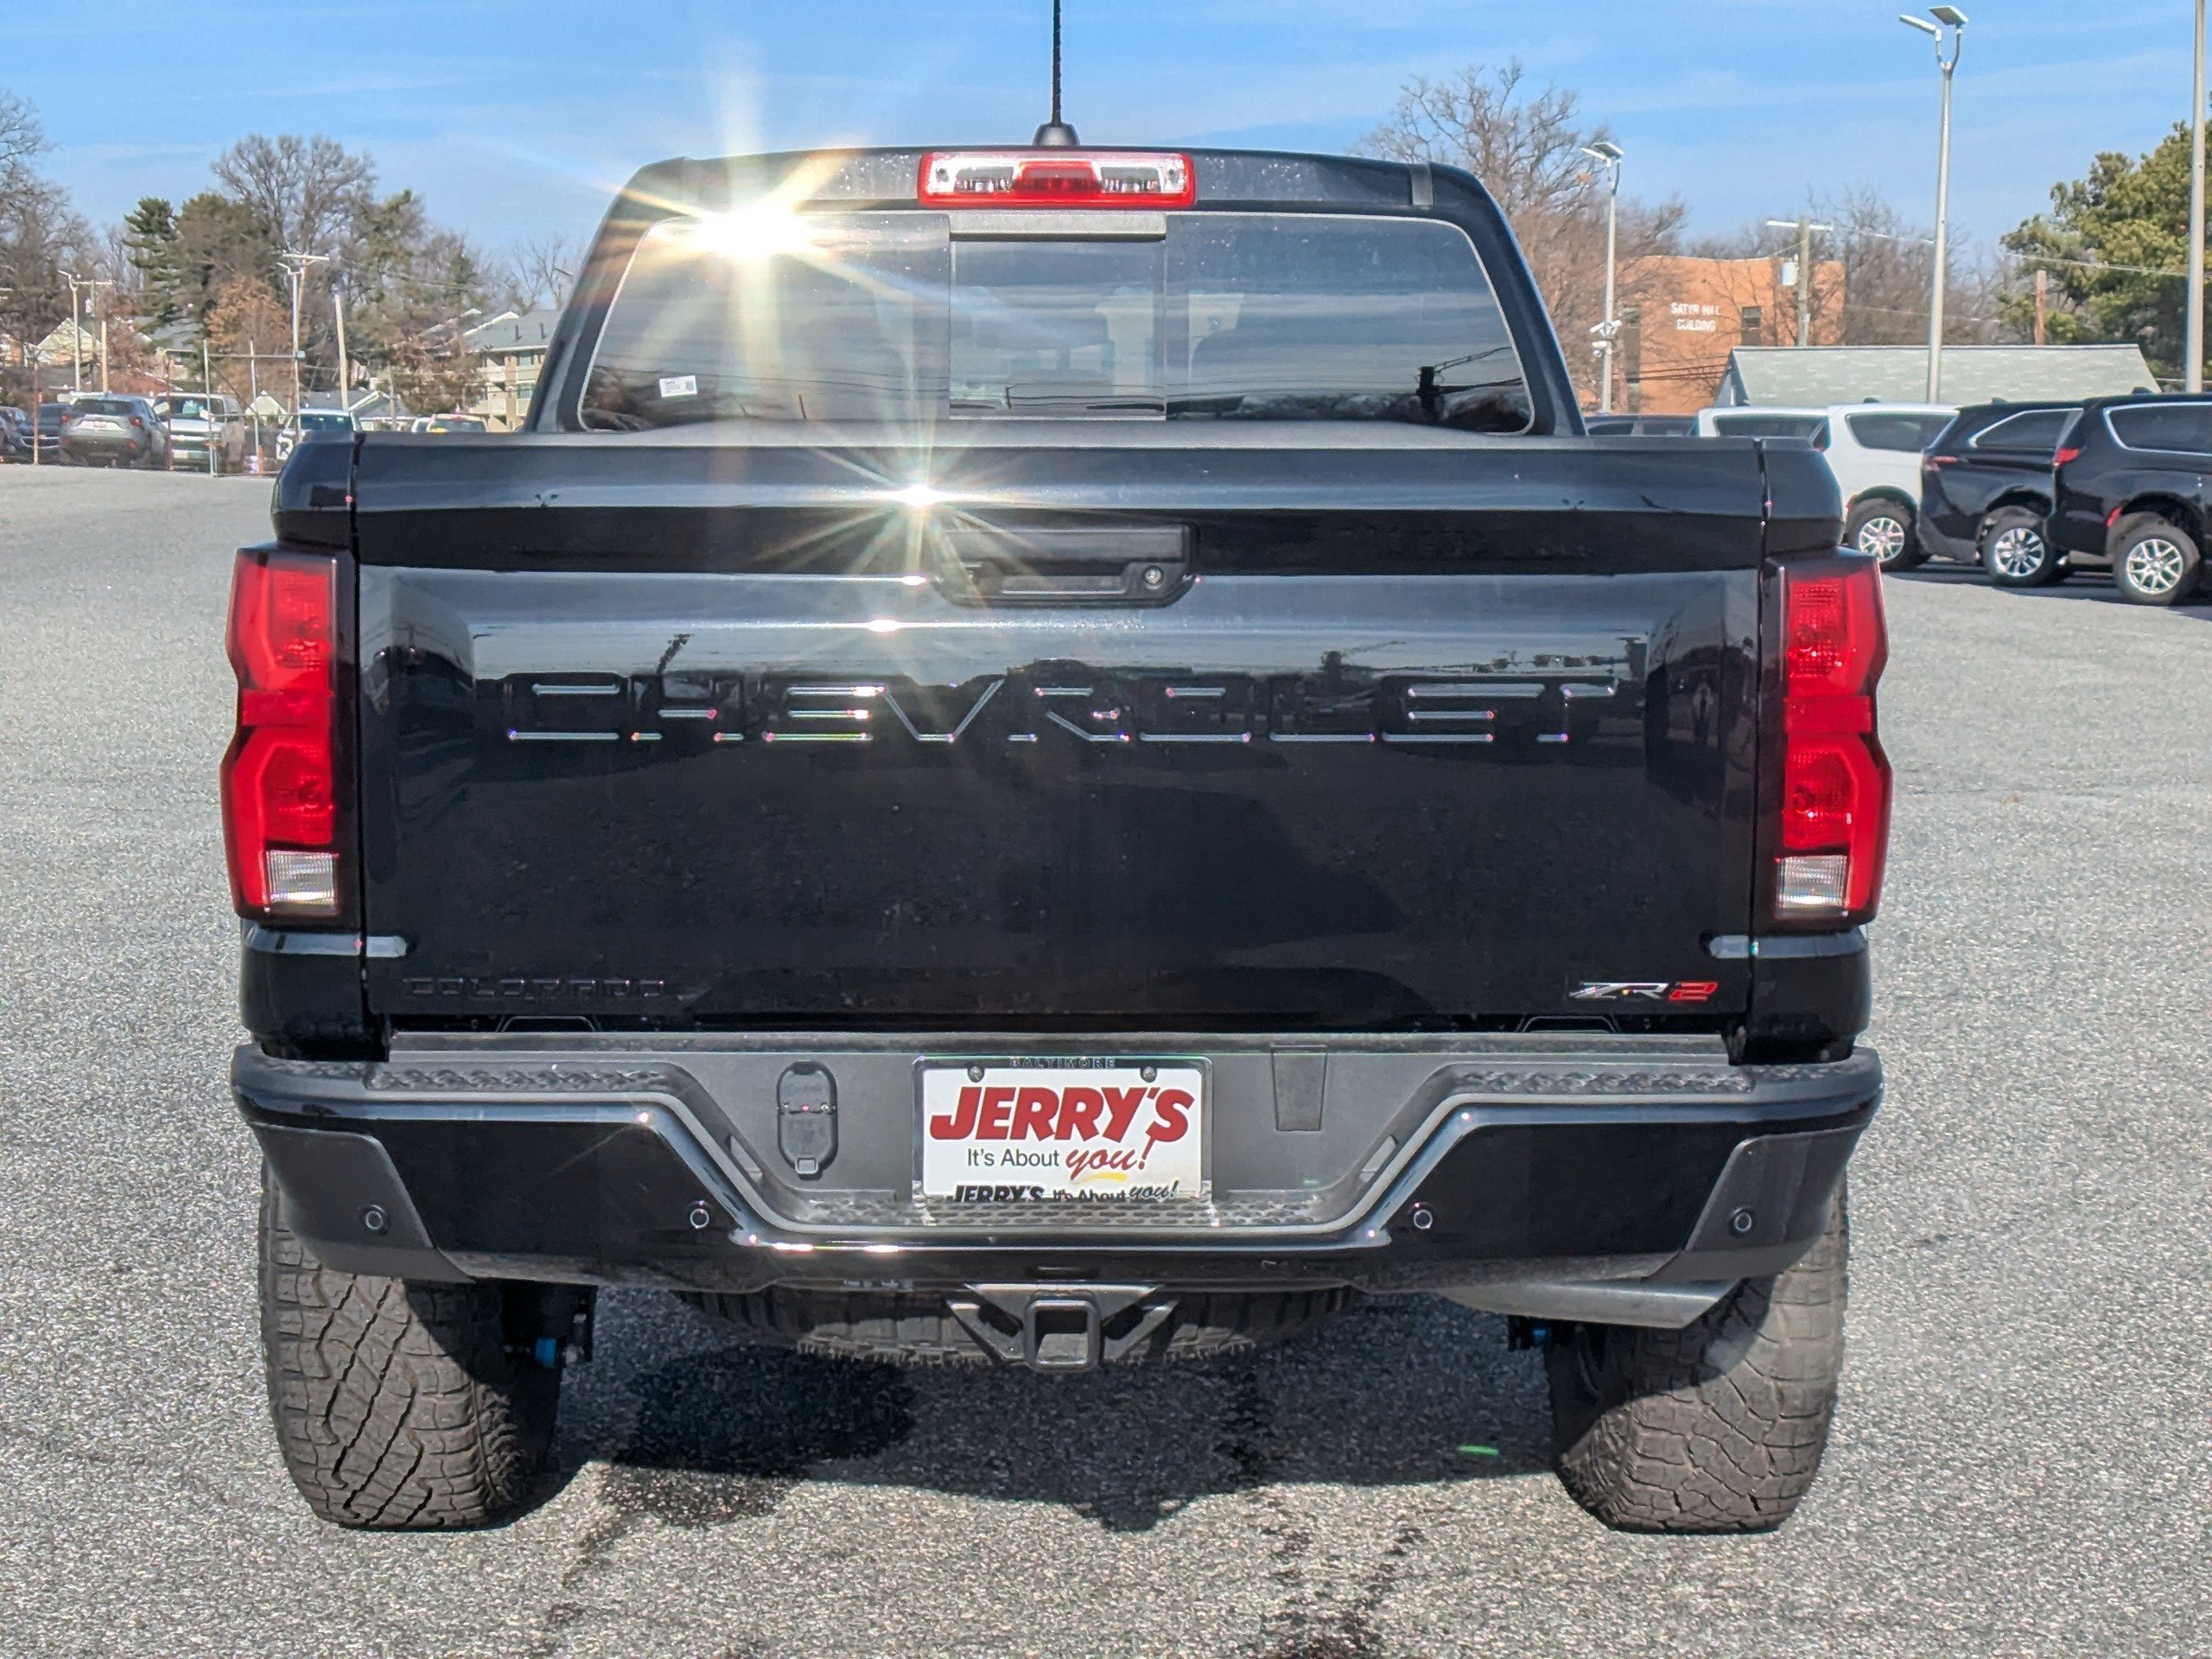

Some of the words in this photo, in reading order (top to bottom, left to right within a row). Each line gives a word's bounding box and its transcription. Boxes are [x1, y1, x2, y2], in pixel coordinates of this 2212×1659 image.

[1567, 981, 1719, 1002] ZR2
[1009, 1058, 1116, 1070] BALTIMORE
[929, 1086, 1195, 1143] JERRY'S
[967, 1148, 995, 1166] It's
[1001, 1148, 1059, 1167] About
[1065, 1137, 1155, 1180] you!
[1128, 1180, 1179, 1200] you!
